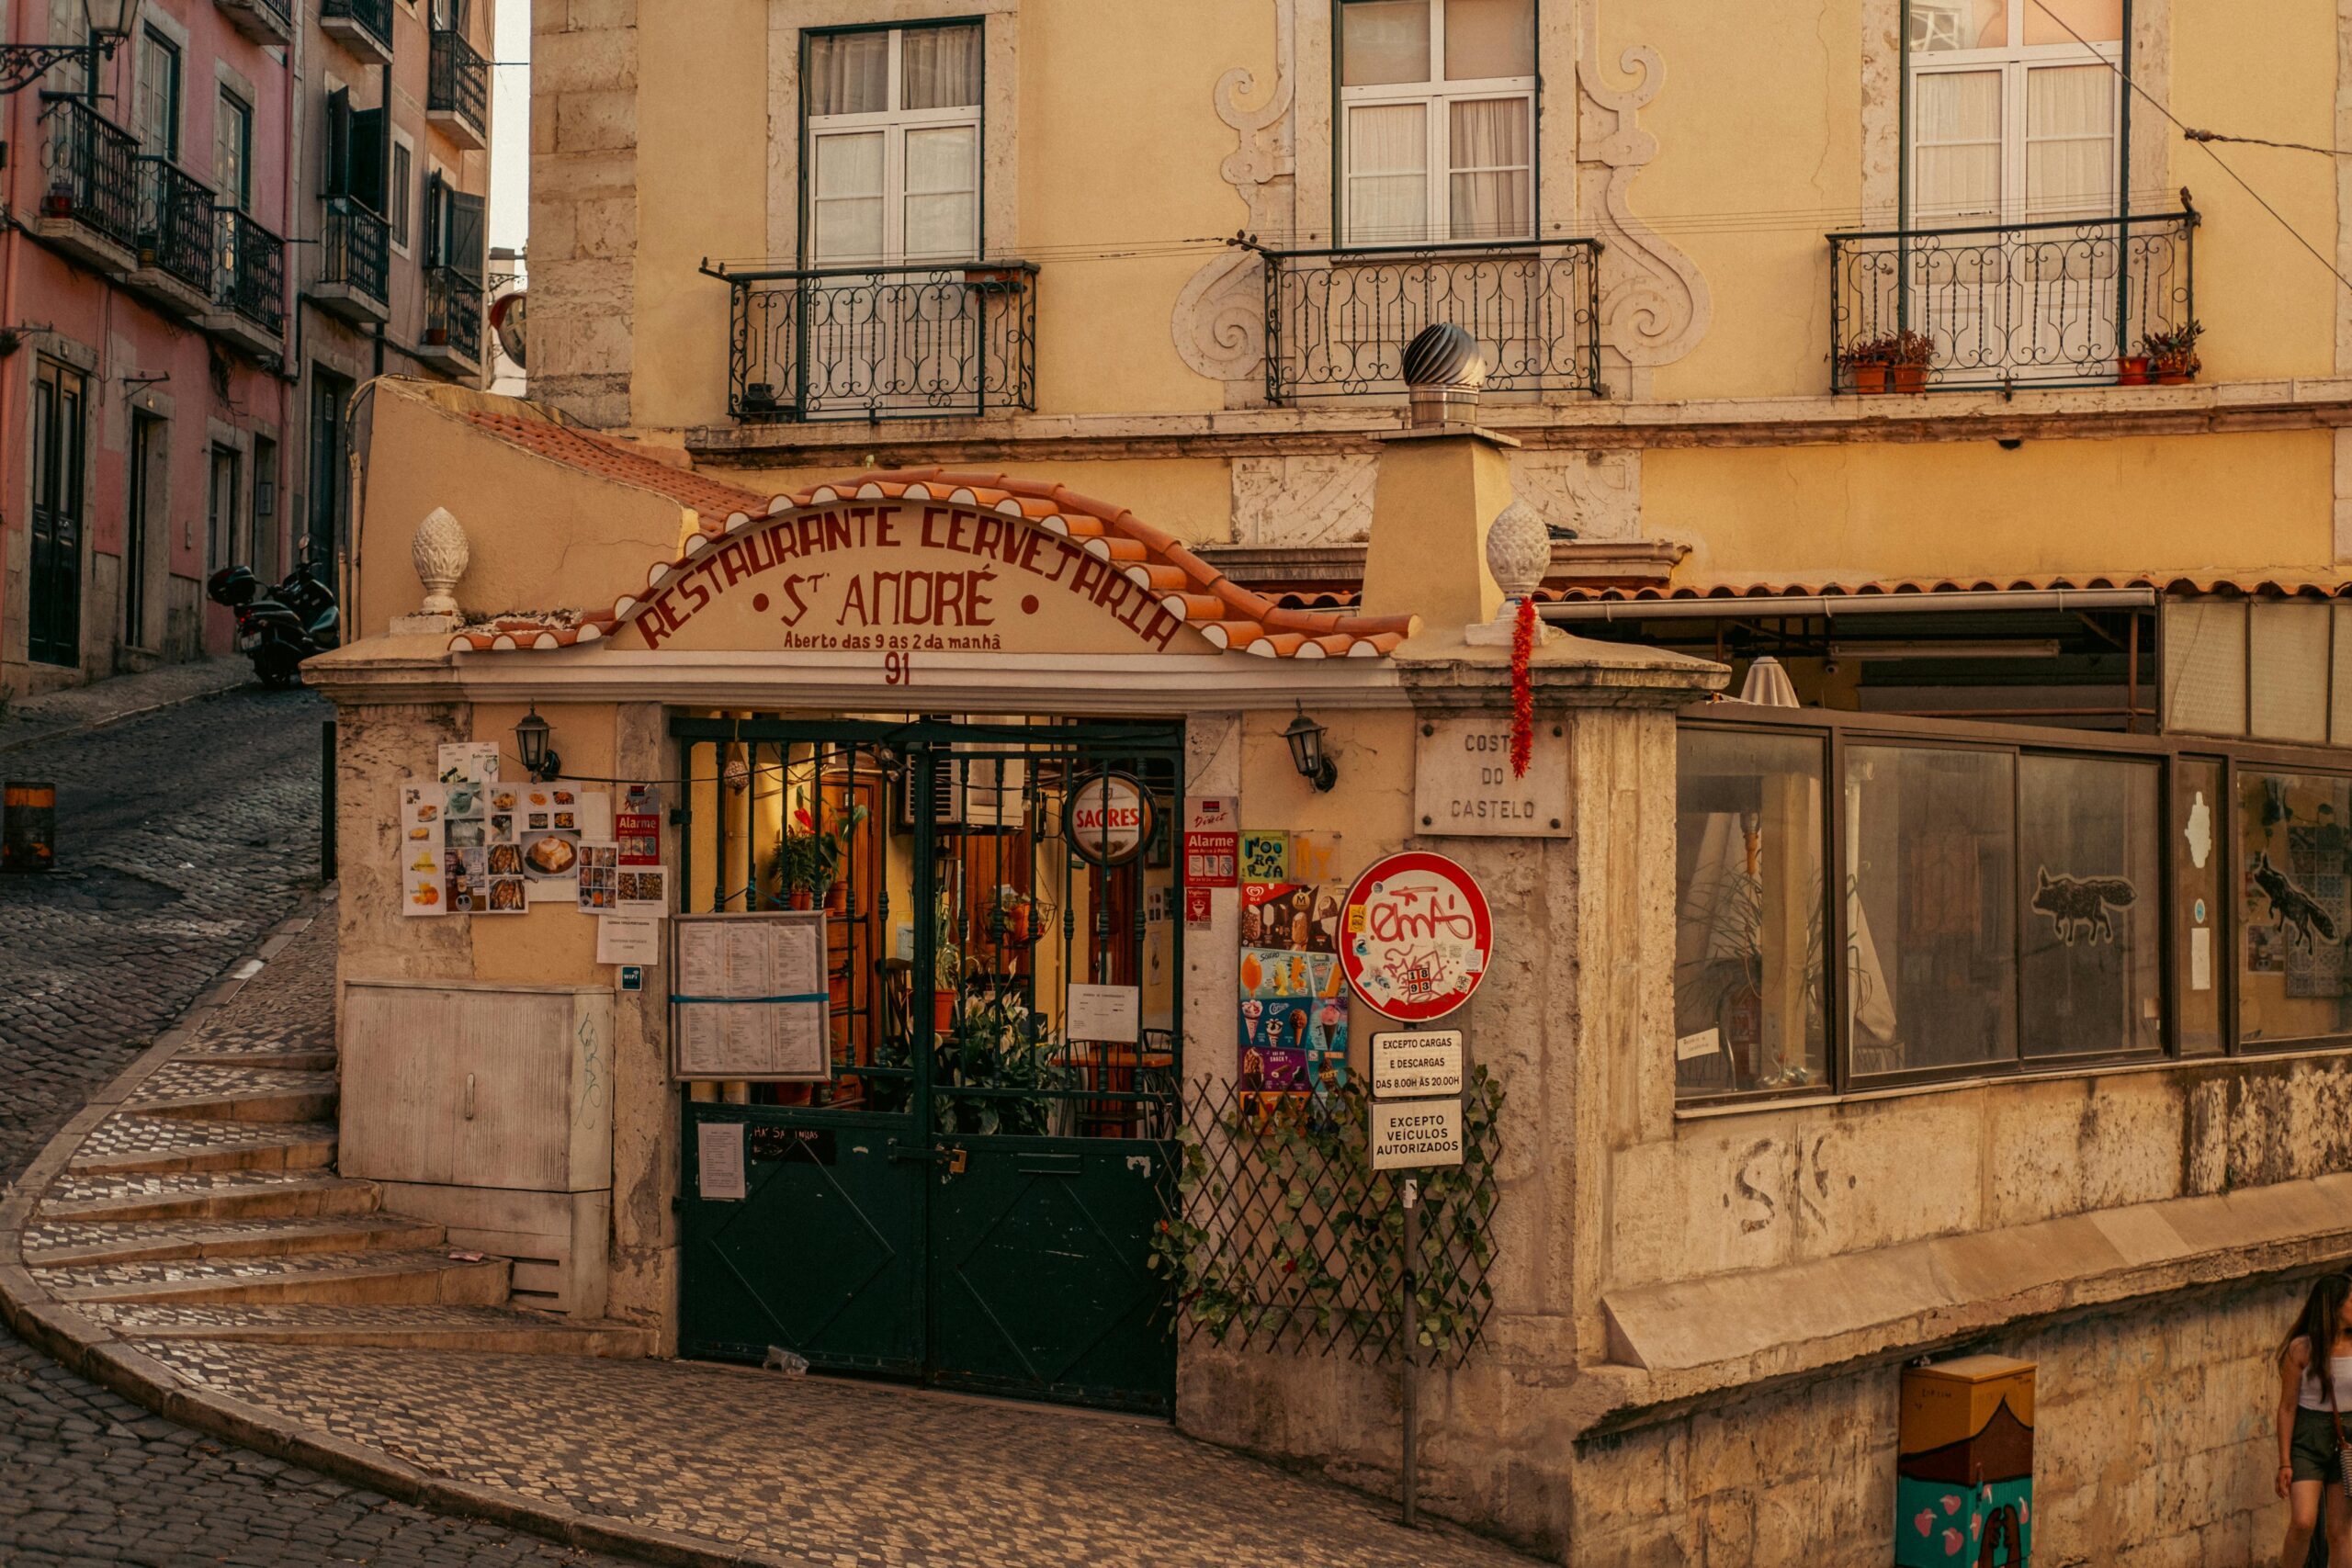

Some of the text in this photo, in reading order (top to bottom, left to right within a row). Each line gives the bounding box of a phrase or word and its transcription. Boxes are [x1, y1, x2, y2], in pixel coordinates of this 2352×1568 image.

[636, 505, 1186, 653] RESTAURANTE CERVEJARIA
[836, 563, 998, 627] ANDRÉ
[784, 630, 837, 649] Aberto
[842, 634, 871, 649] das
[875, 634, 885, 649] 9
[912, 634, 922, 649] 2
[924, 633, 944, 649] da
[884, 650, 910, 685] 91
[1464, 734, 1519, 752] COST
[1481, 767, 1504, 785] DO
[1451, 800, 1535, 818] CASTELO
[619, 817, 656, 829] Alarme
[1189, 834, 1234, 847] Alarme
[1383, 1037, 1453, 1049] EXCEPTO CARGAS
[1390, 1057, 1445, 1069] E DESCARGAS
[1375, 1079, 1392, 1089] DAS
[1394, 1077, 1418, 1089] 8.00H
[1431, 1076, 1460, 1087] 20.00H
[1390, 1114, 1444, 1128] EXCEPTO
[1387, 1128, 1449, 1142] VEÍCULOS
[1376, 1140, 1459, 1156] AUTORIZADOS
